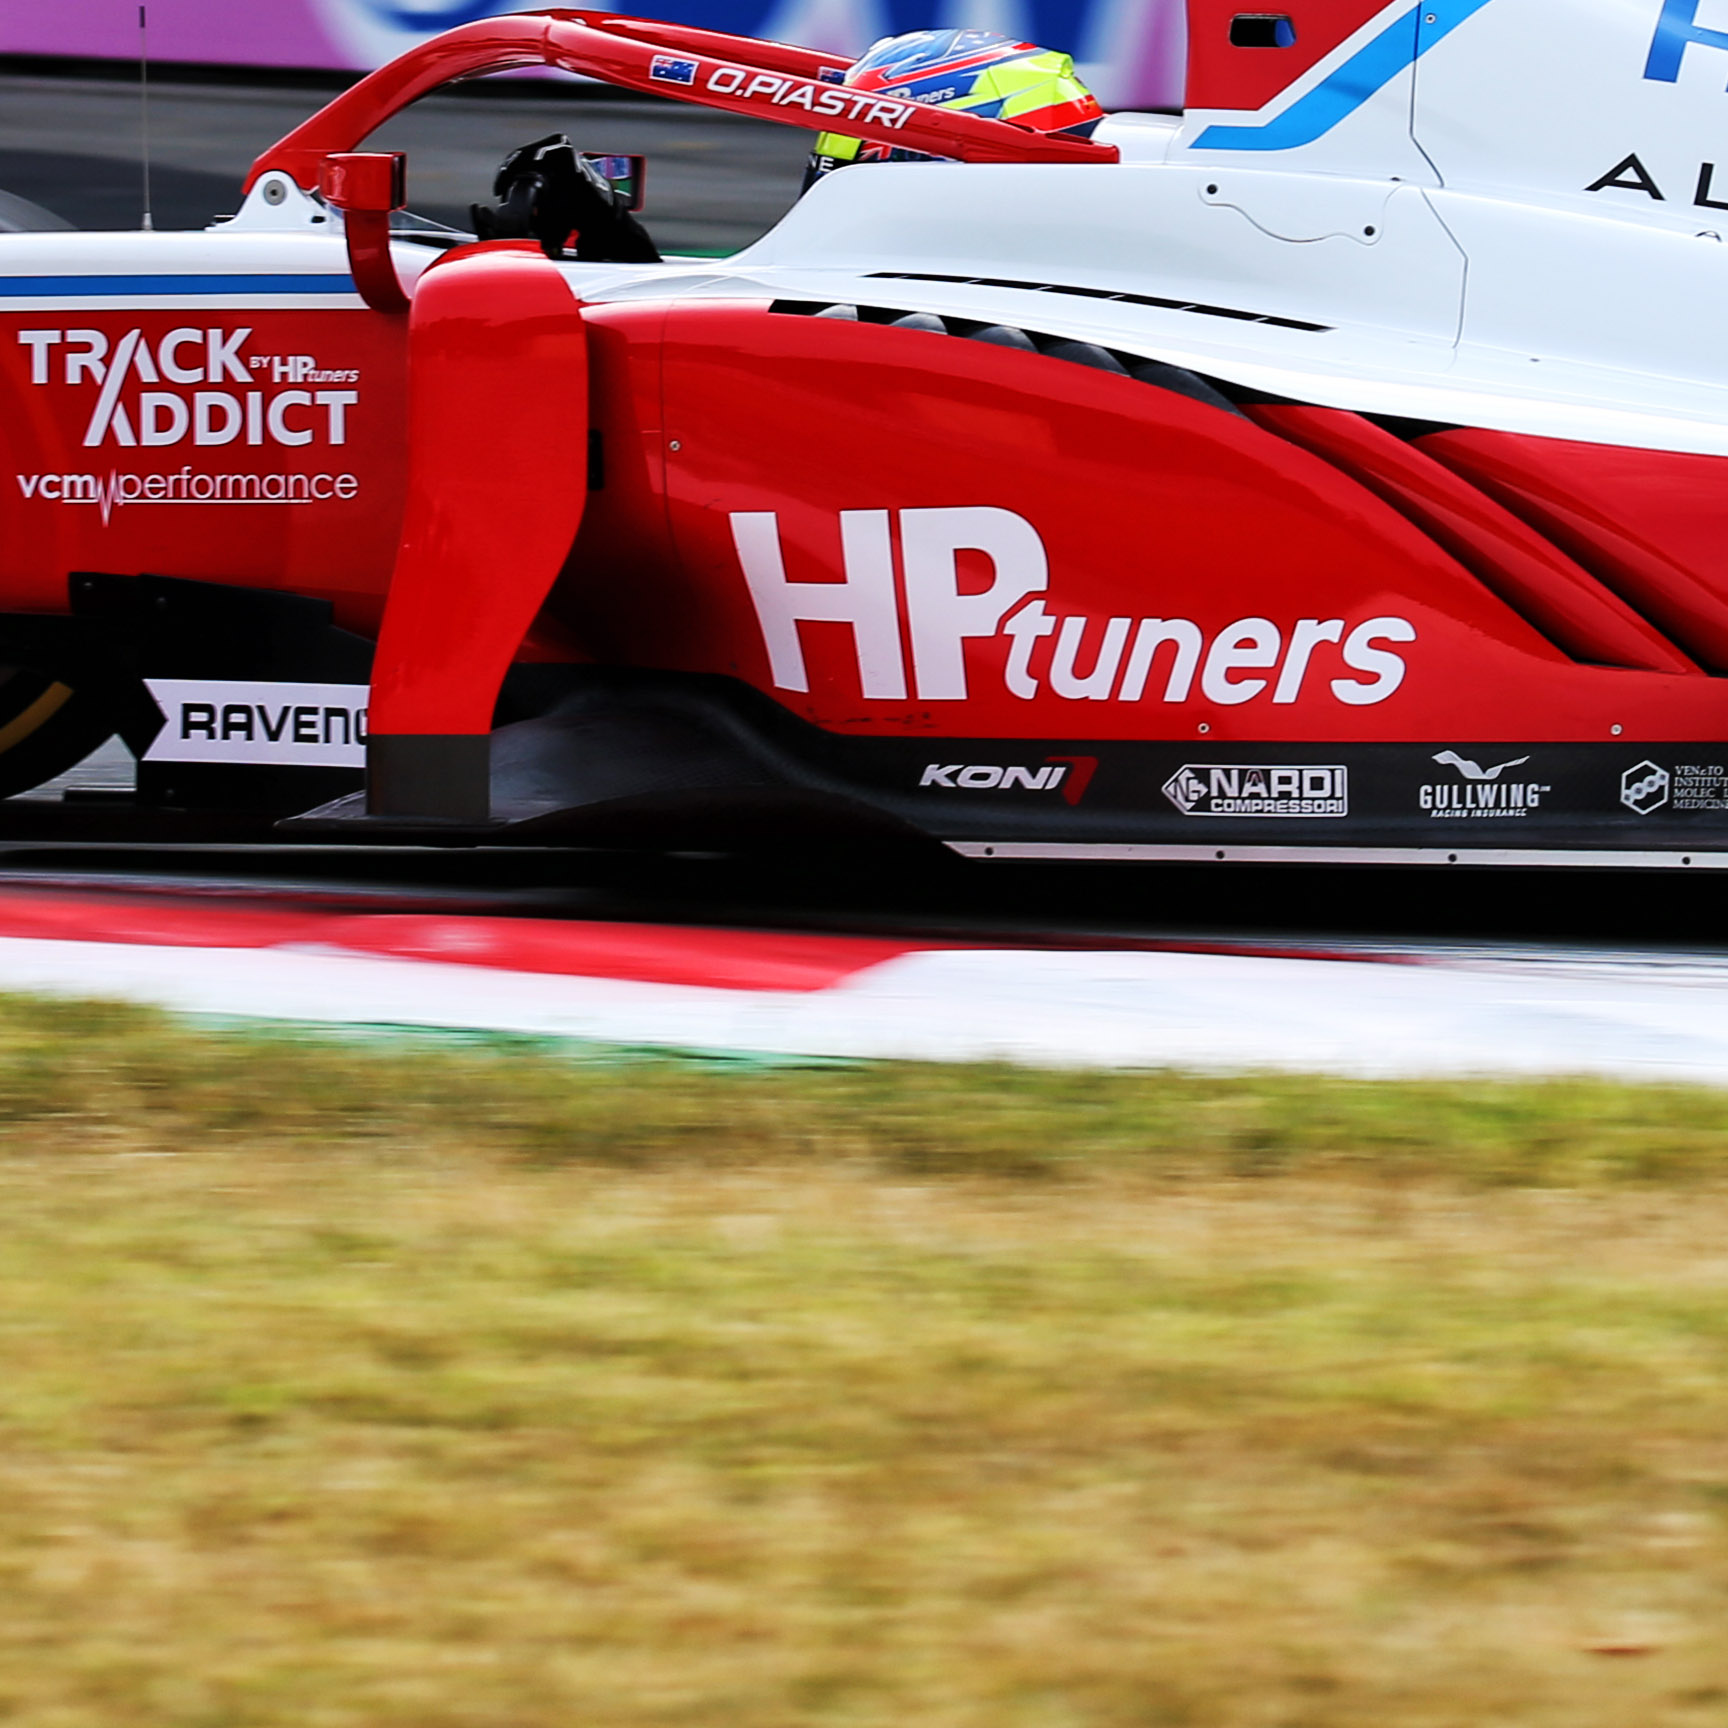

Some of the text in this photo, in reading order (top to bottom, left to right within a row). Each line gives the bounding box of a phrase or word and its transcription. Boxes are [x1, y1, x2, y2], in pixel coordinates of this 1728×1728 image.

[705, 68, 916, 130] O.PIASTRI
[17, 327, 255, 386] TRACK
[249, 355, 270, 369] BY
[82, 389, 359, 447] ADDICT
[918, 764, 1067, 791] KONI
[1209, 769, 1344, 799] NARDI
[1210, 798, 1343, 813] COMPRESSORI
[1419, 783, 1540, 809] GULLWING
[1430, 808, 1528, 818] RACING INSURANCE
